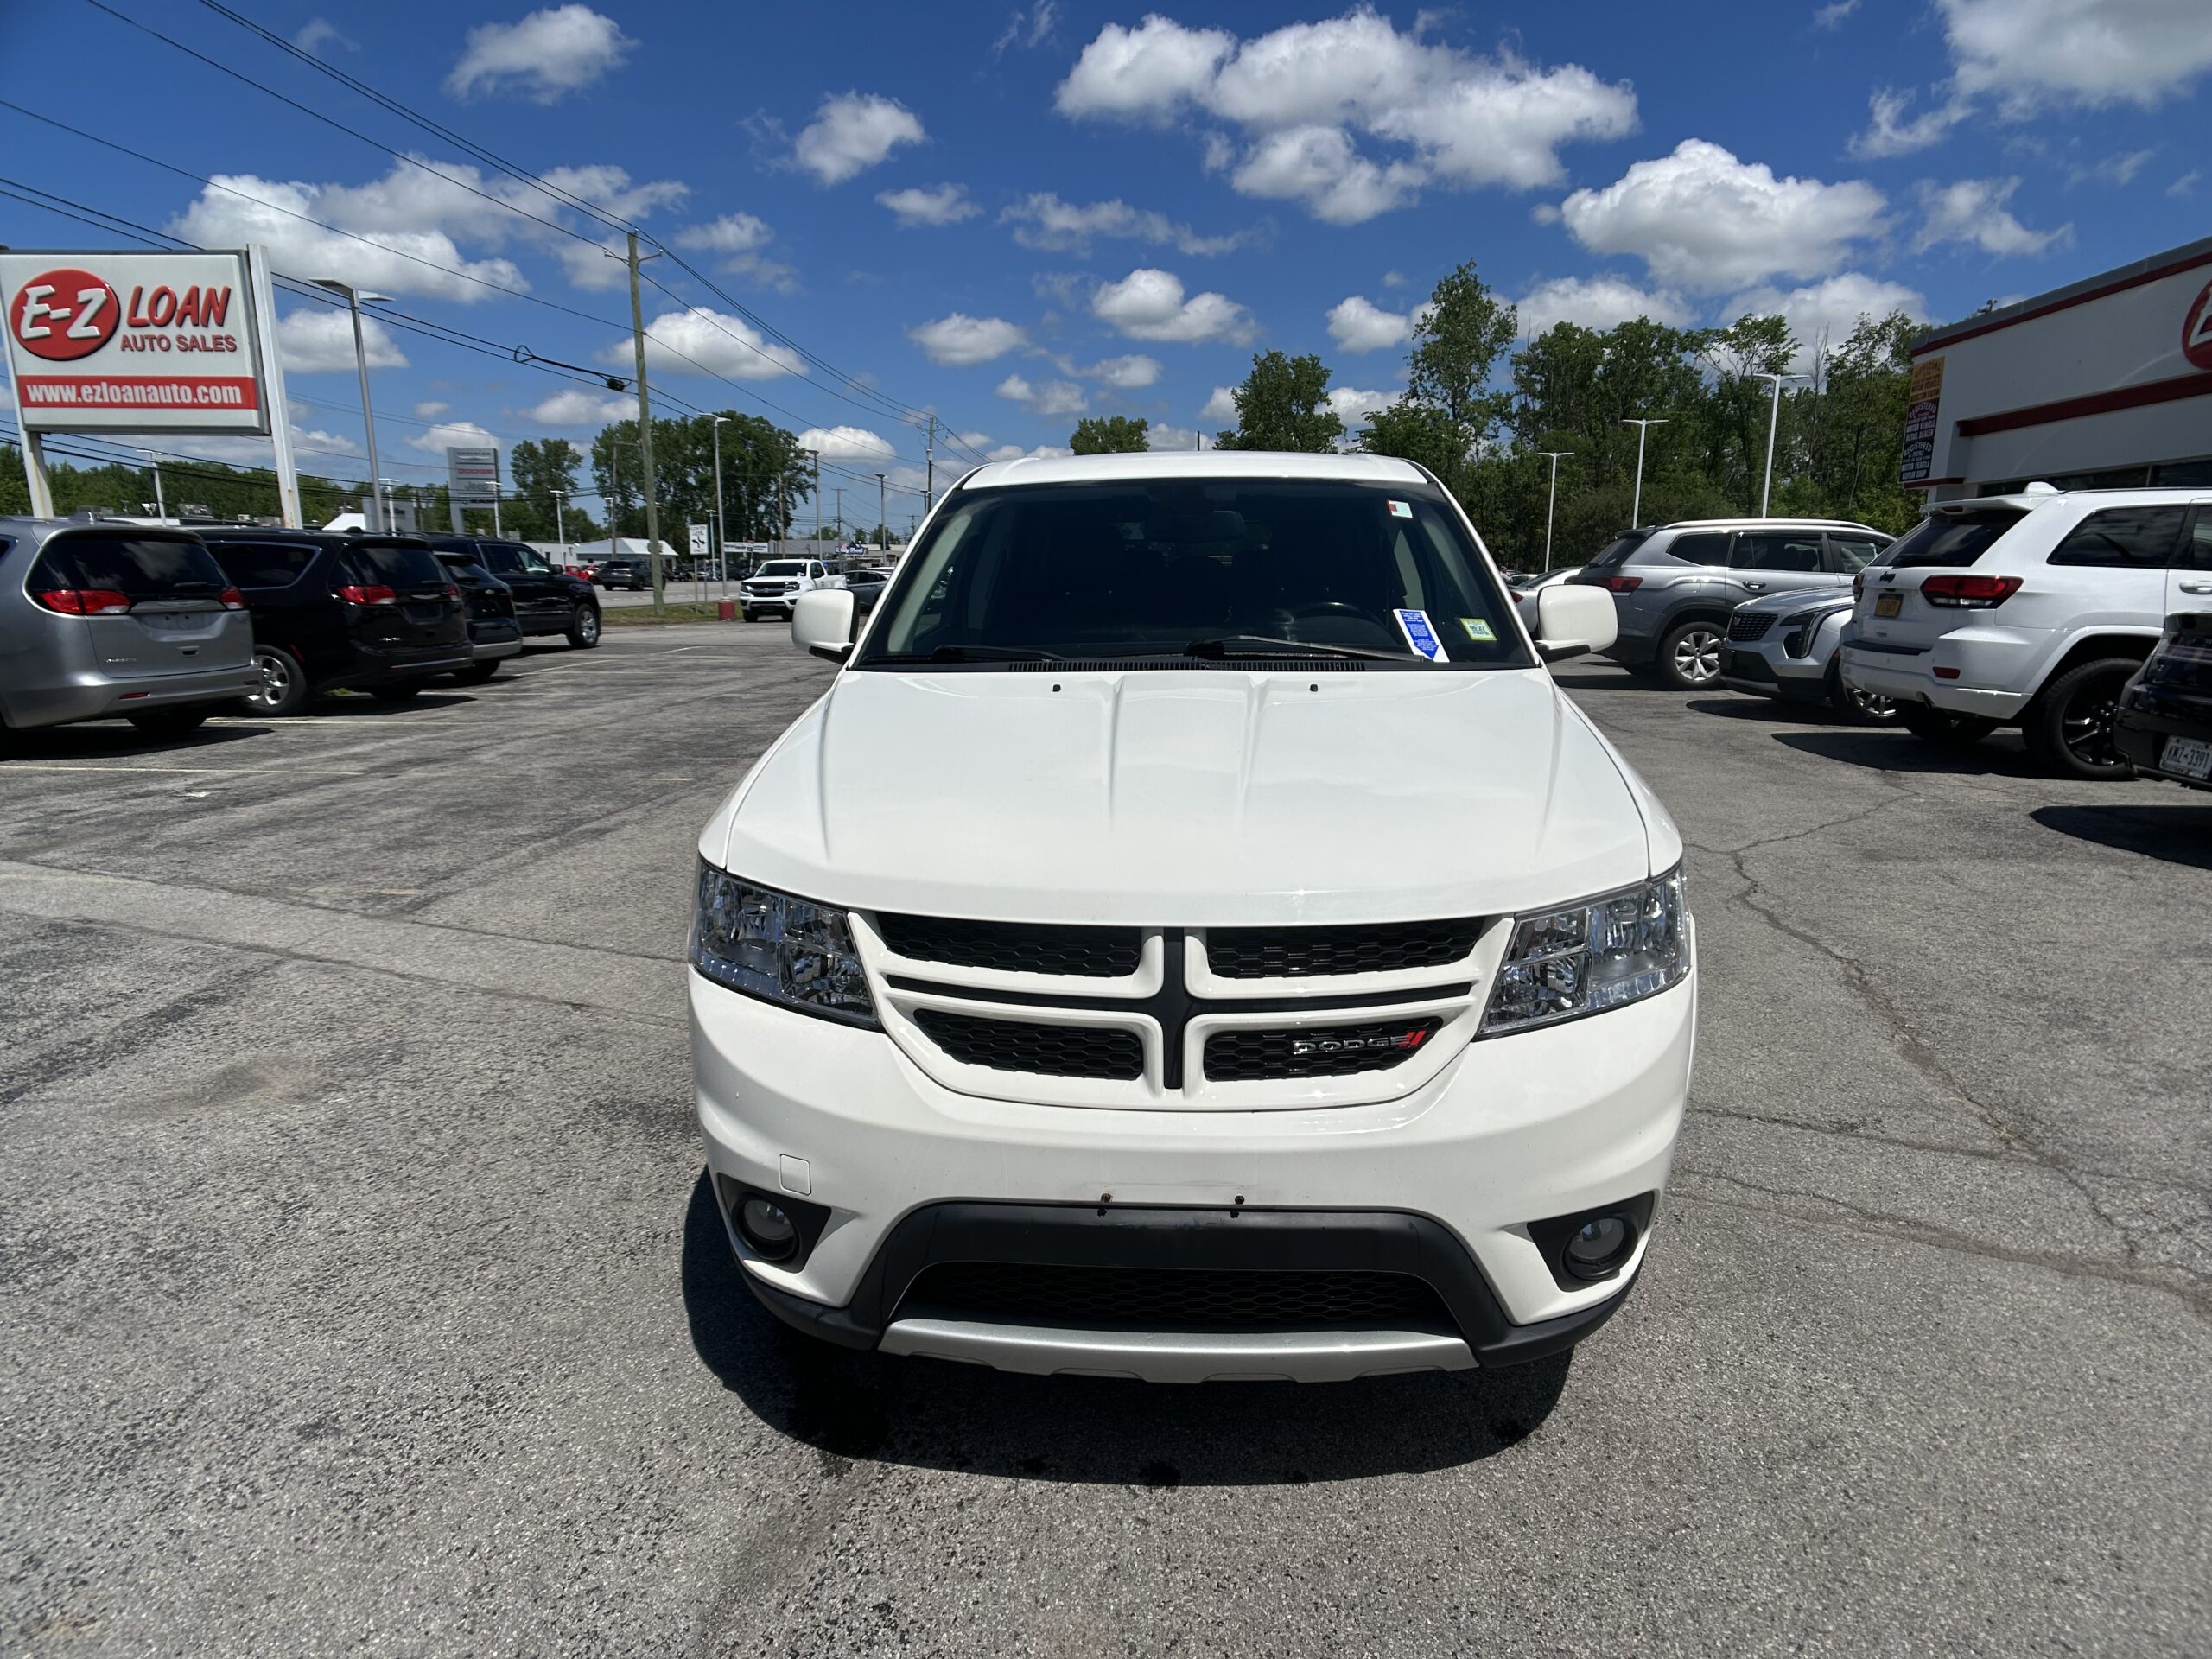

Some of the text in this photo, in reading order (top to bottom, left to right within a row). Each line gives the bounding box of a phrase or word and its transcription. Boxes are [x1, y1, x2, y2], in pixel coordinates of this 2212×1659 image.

[20, 284, 107, 340] E-Z
[126, 284, 232, 327] LOAN
[120, 334, 238, 353] AUTO SALES
[25, 381, 243, 404] www.ezloanauto.com
[1293, 1036, 1411, 1055] DODGE
